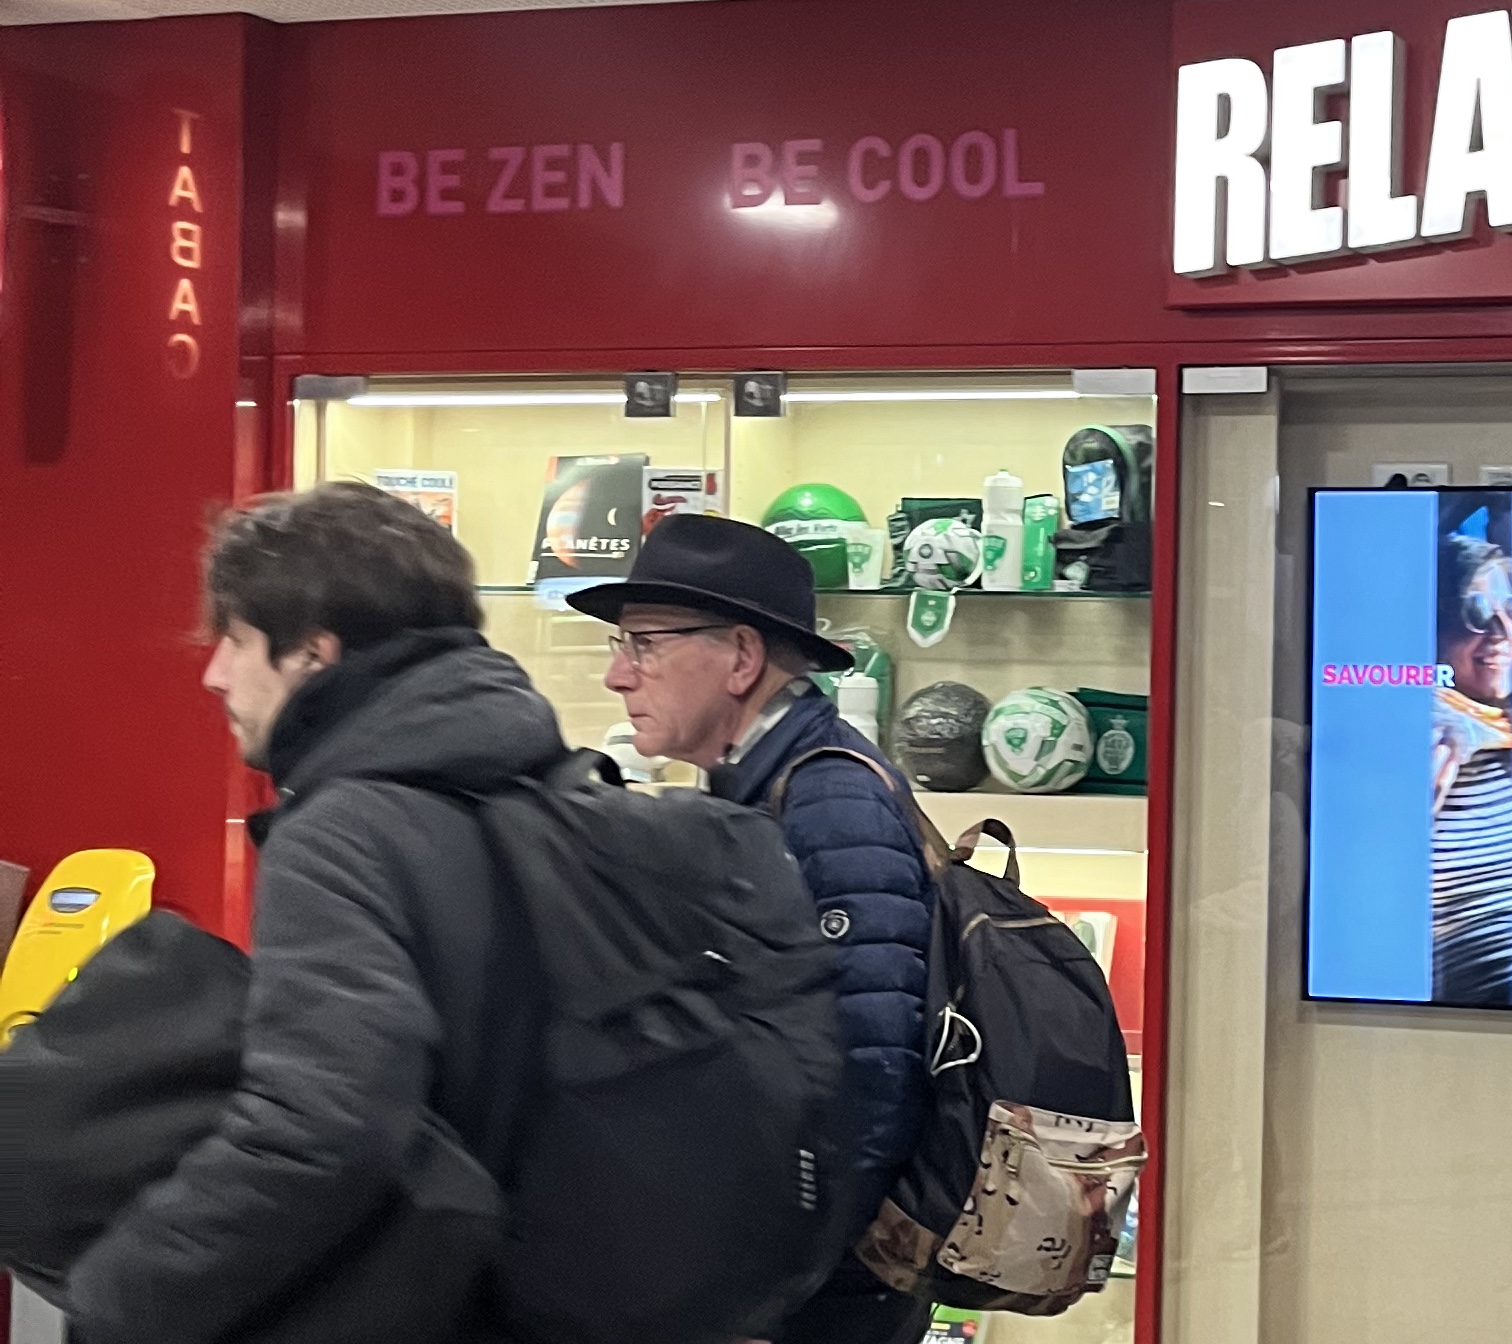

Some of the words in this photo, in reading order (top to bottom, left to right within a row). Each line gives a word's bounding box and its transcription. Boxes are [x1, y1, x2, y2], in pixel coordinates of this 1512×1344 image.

[376, 149, 467, 217] BE
[486, 141, 626, 212] ZEN
[729, 138, 824, 210] BE
[847, 128, 1046, 204] COOL
[1321, 662, 1456, 689] SAVOURER
